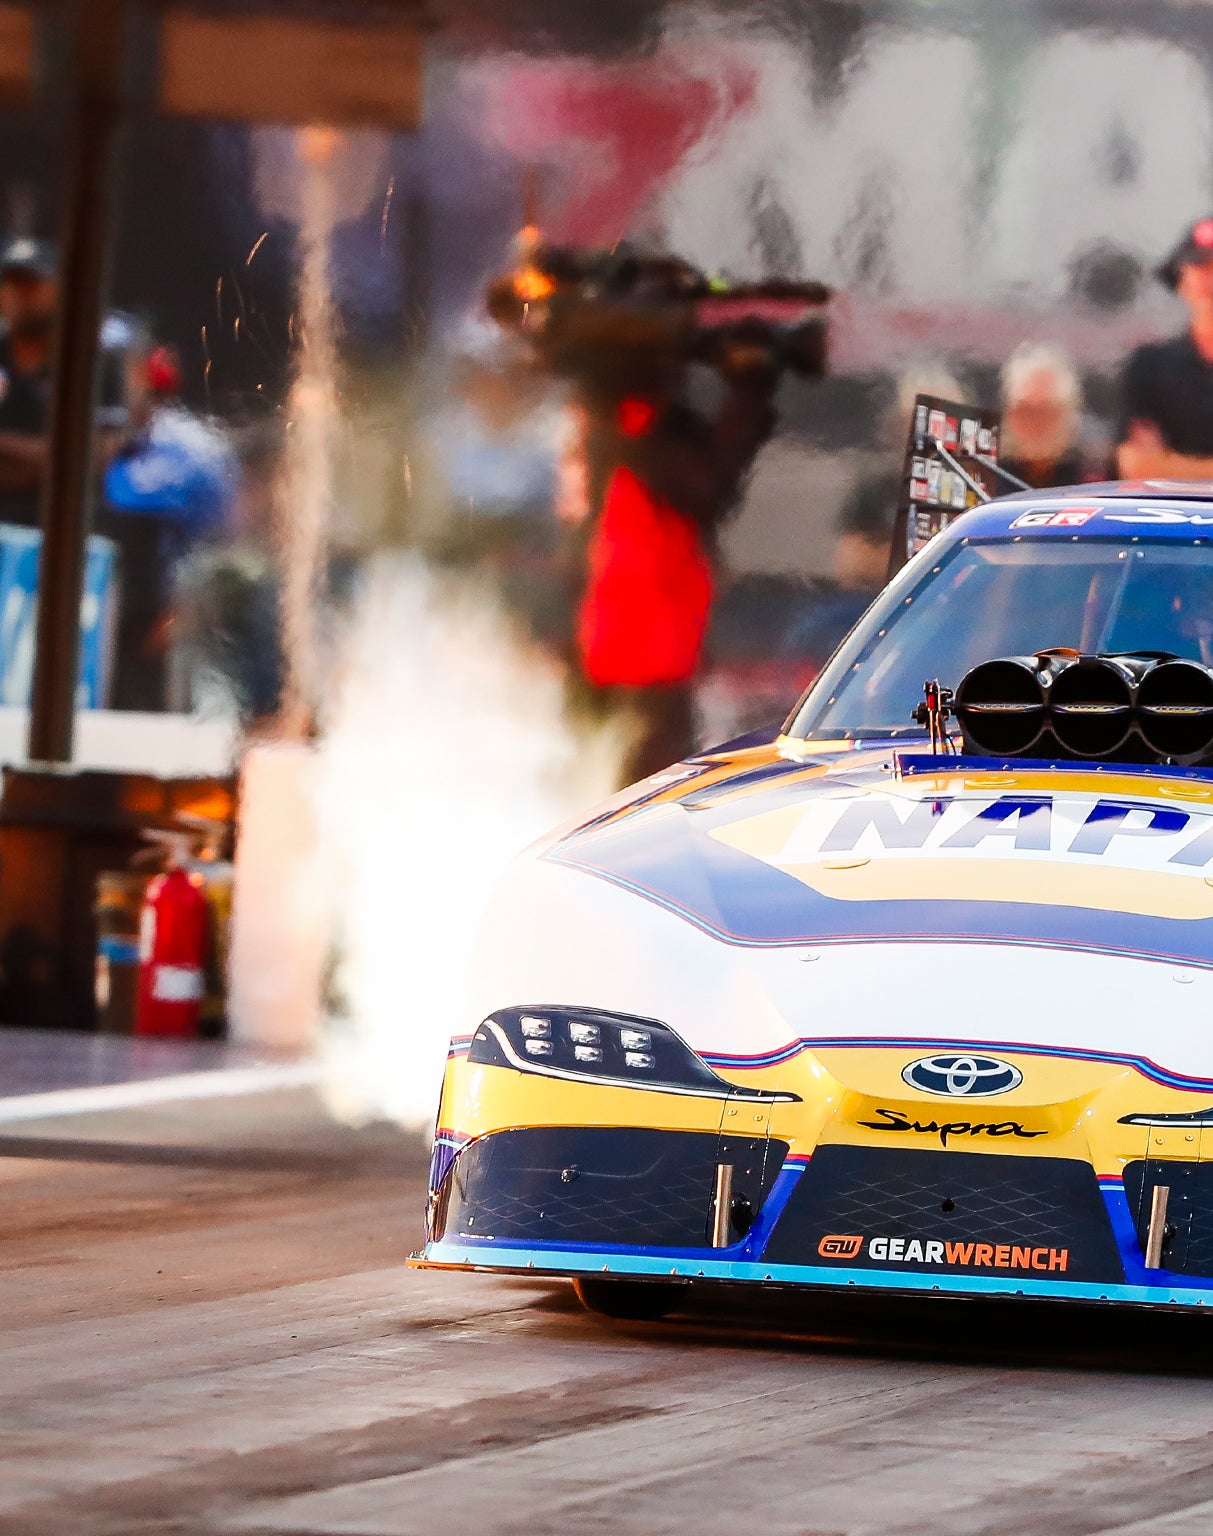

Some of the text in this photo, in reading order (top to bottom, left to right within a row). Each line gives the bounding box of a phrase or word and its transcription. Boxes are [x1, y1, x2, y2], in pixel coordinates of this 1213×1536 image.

[1011, 509, 1095, 528] GR
[857, 1109, 1049, 1147] Supra
[869, 1238, 1068, 1271] GEARWRENCH
